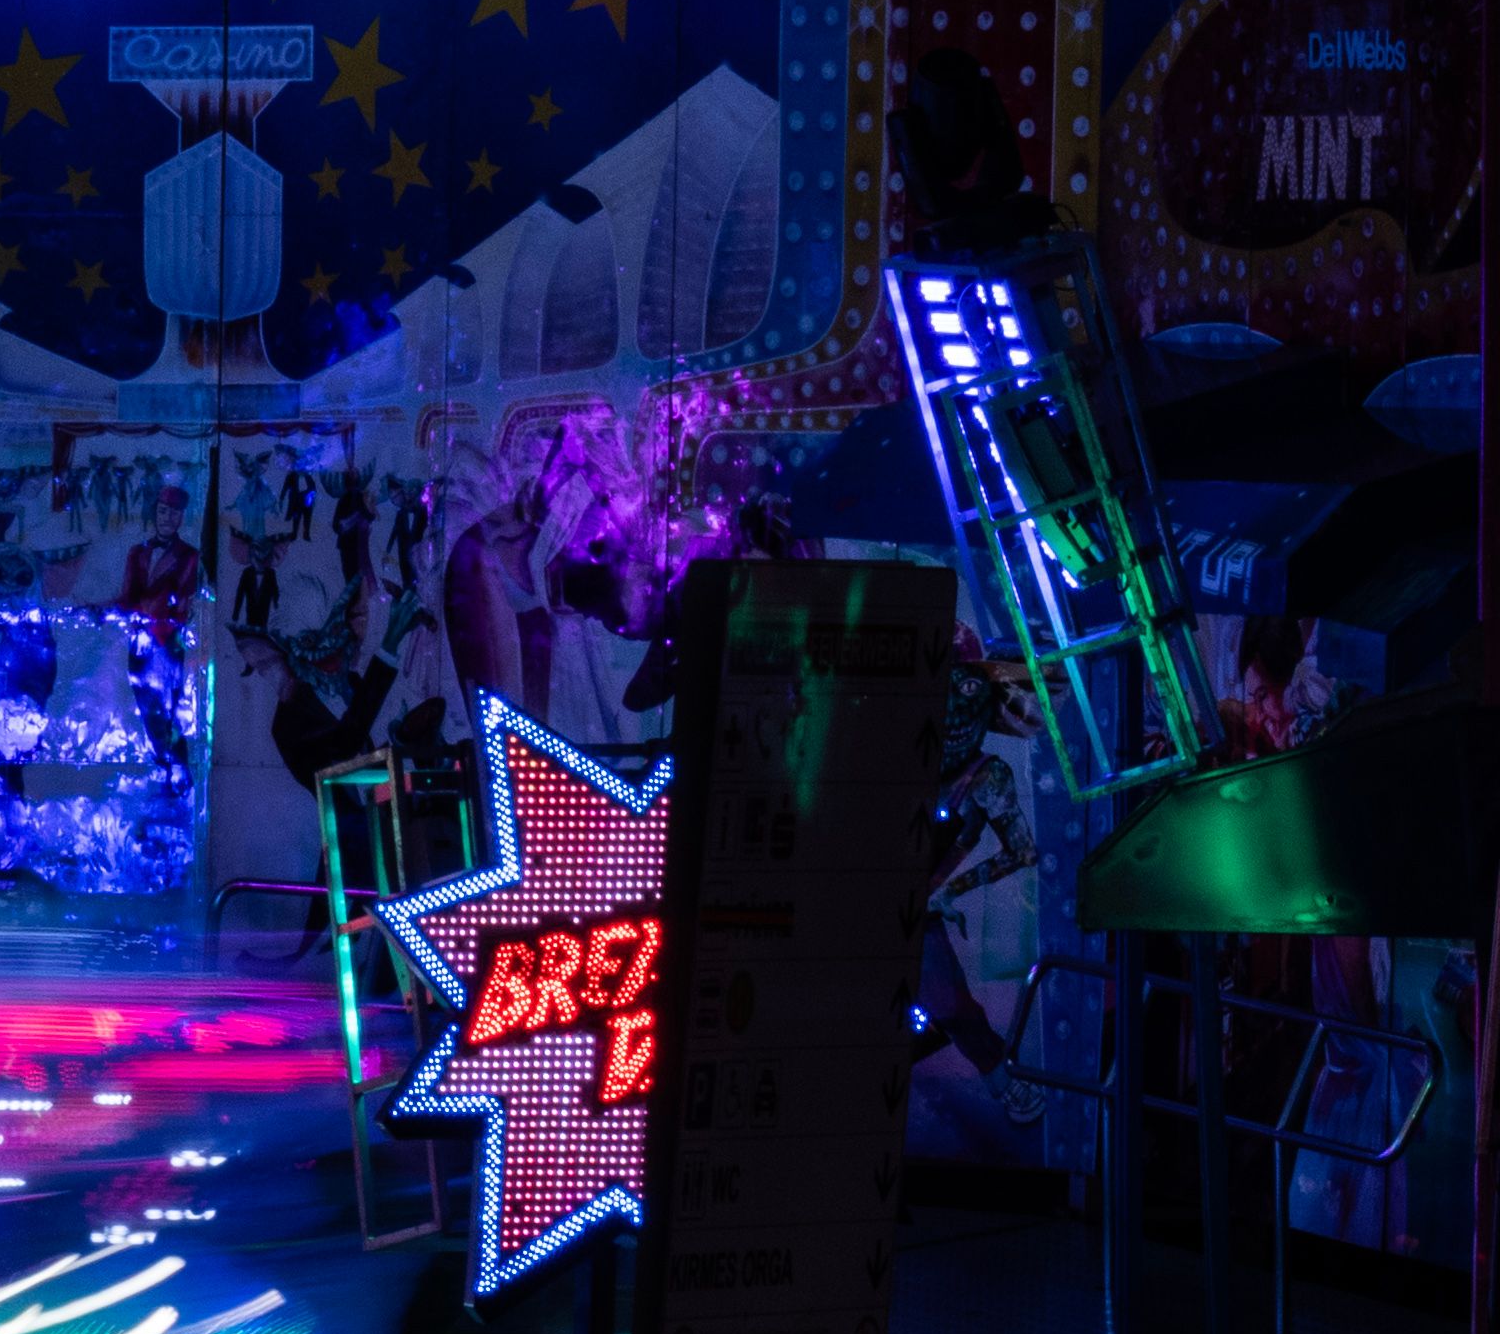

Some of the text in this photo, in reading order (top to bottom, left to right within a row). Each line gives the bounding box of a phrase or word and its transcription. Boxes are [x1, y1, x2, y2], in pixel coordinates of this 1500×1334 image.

[123, 30, 306, 73] Casino
[1307, 31, 1343, 71] Del
[1254, 112, 1384, 205] MINT
[810, 630, 913, 669] FEUERWEHR
[467, 917, 661, 1046] BRE
[712, 1163, 742, 1205] WC
[668, 1247, 794, 1292] KIRMES ORGA
